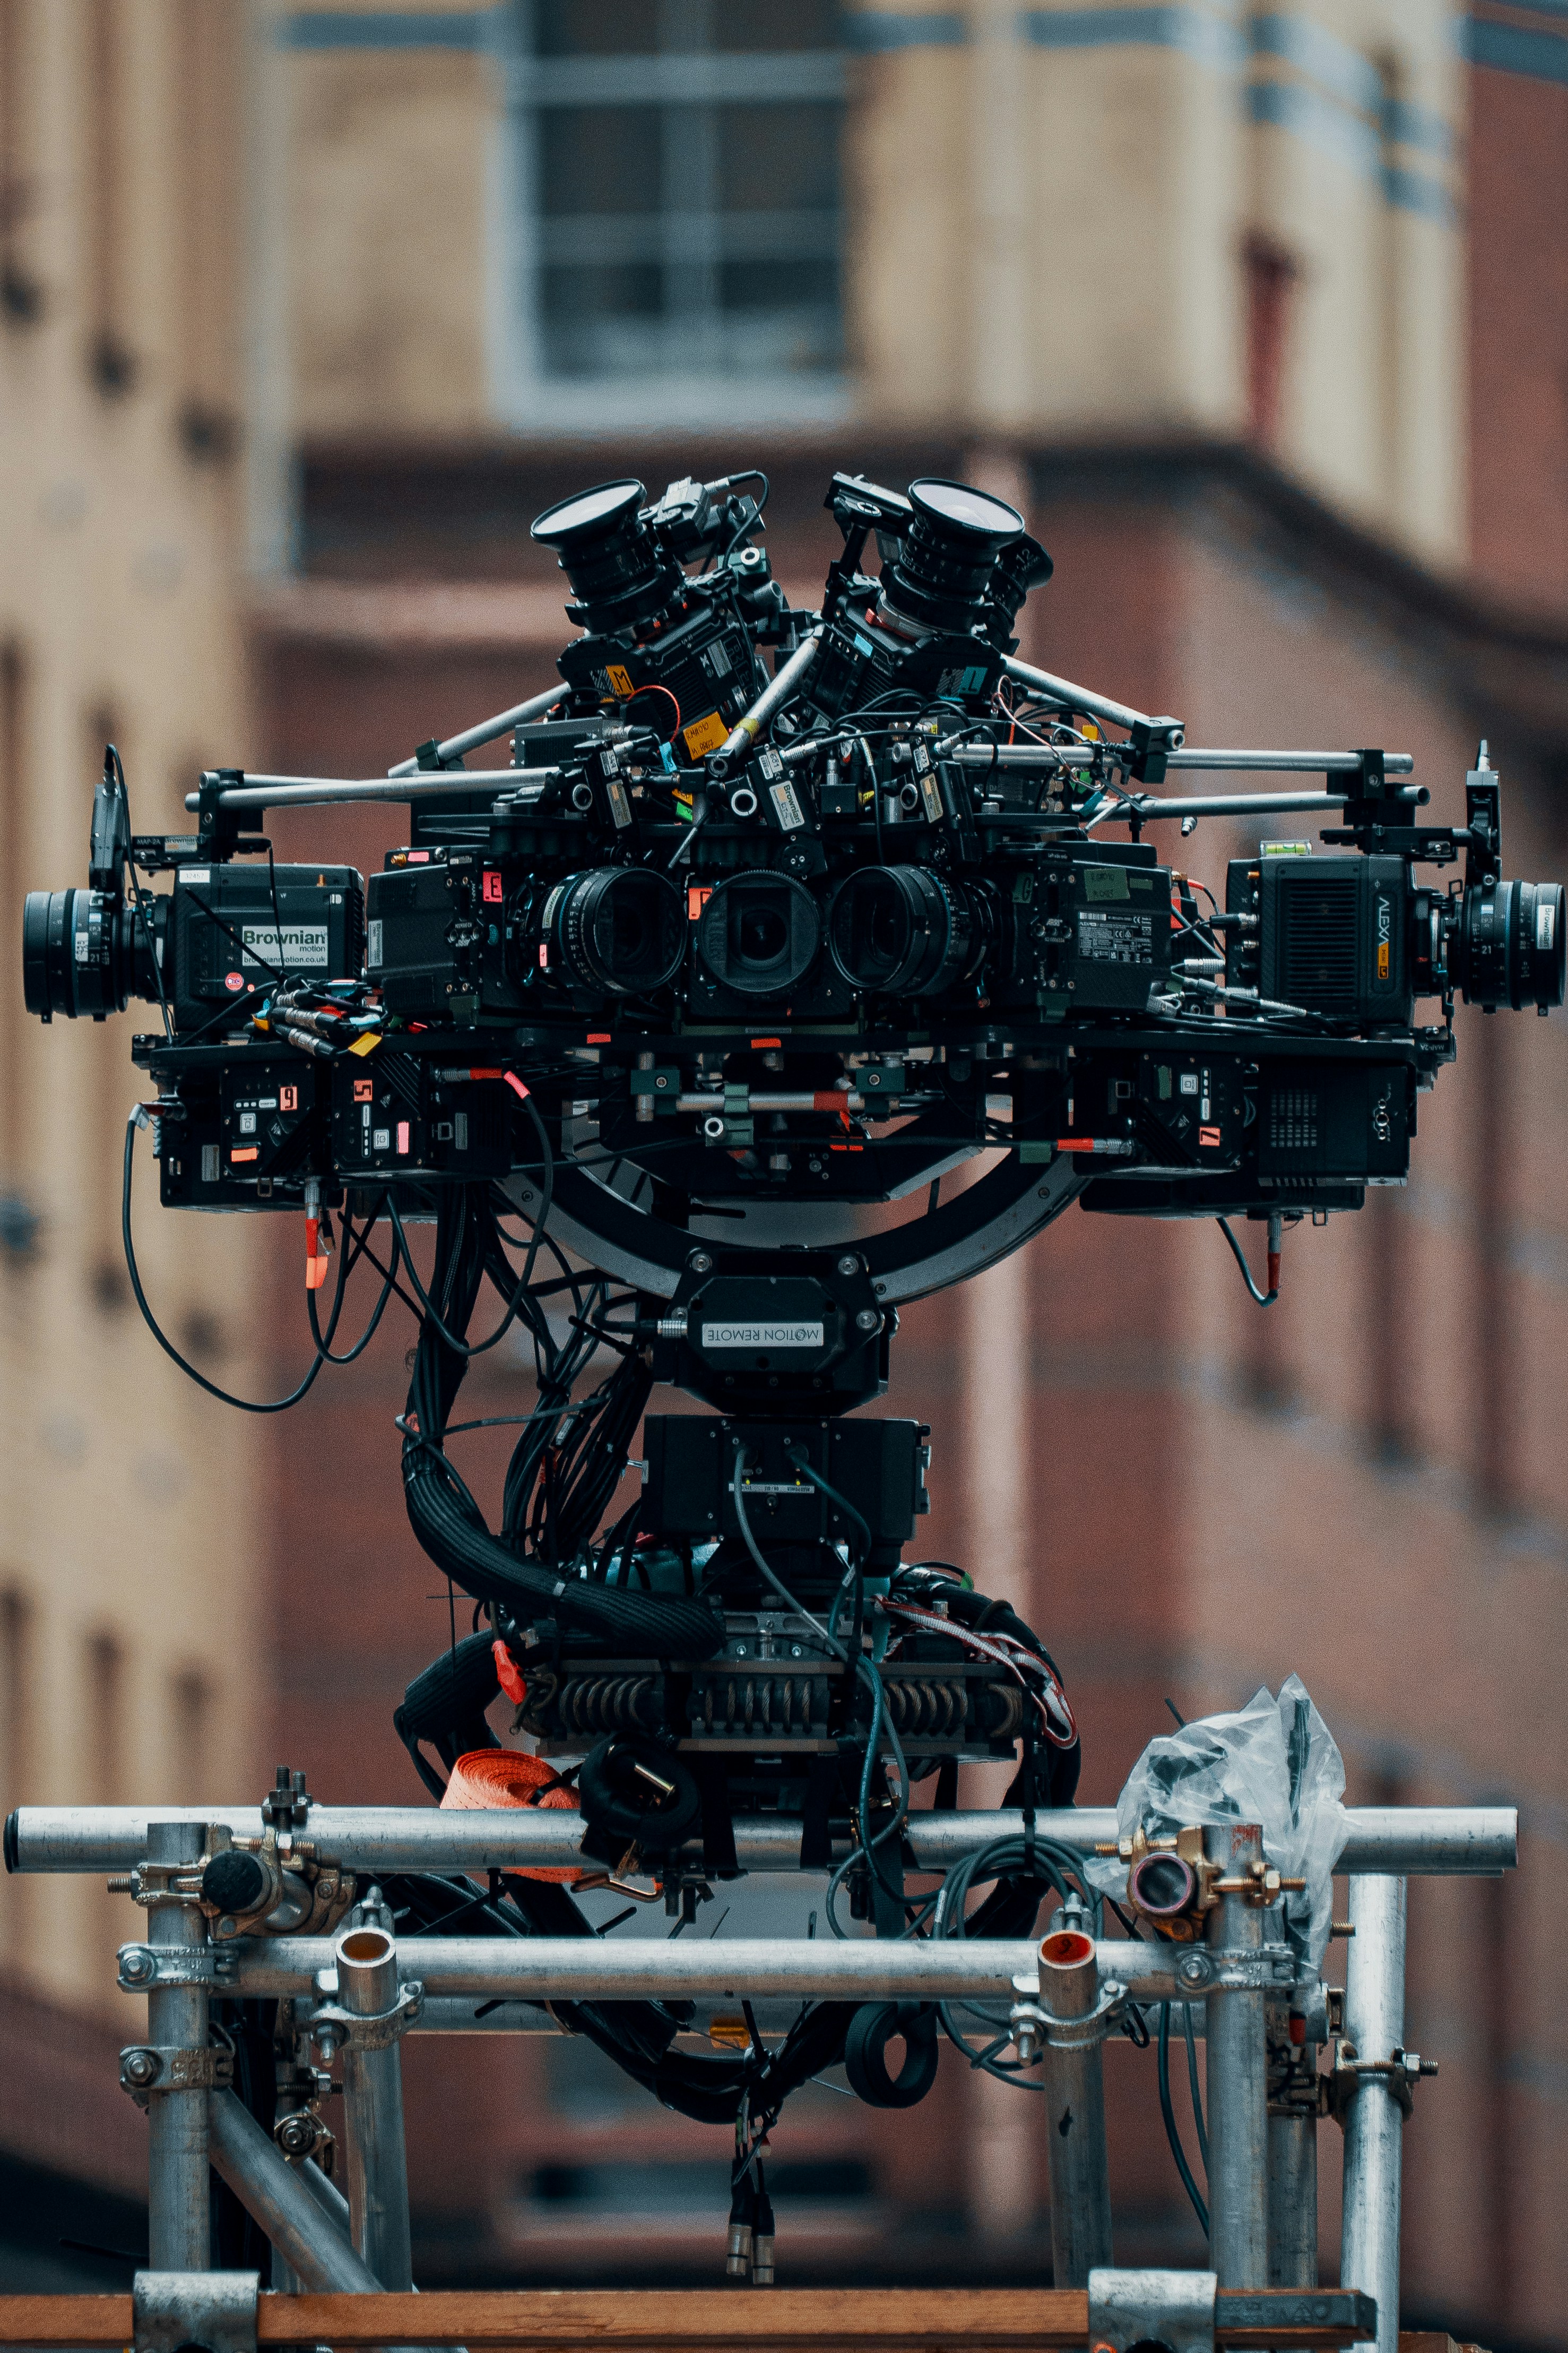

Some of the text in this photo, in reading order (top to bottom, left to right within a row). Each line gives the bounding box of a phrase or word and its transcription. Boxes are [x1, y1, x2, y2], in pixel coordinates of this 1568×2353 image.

[784, 785, 802, 823] Brownian
[1378, 896, 1389, 946] ALEXA
[1543, 908, 1552, 948] Brownian
[244, 930, 325, 944] Brownian
[1482, 945, 1491, 955] 21
[90, 953, 100, 962] 21
[707, 1329, 819, 1341] MOTION REMOTE
